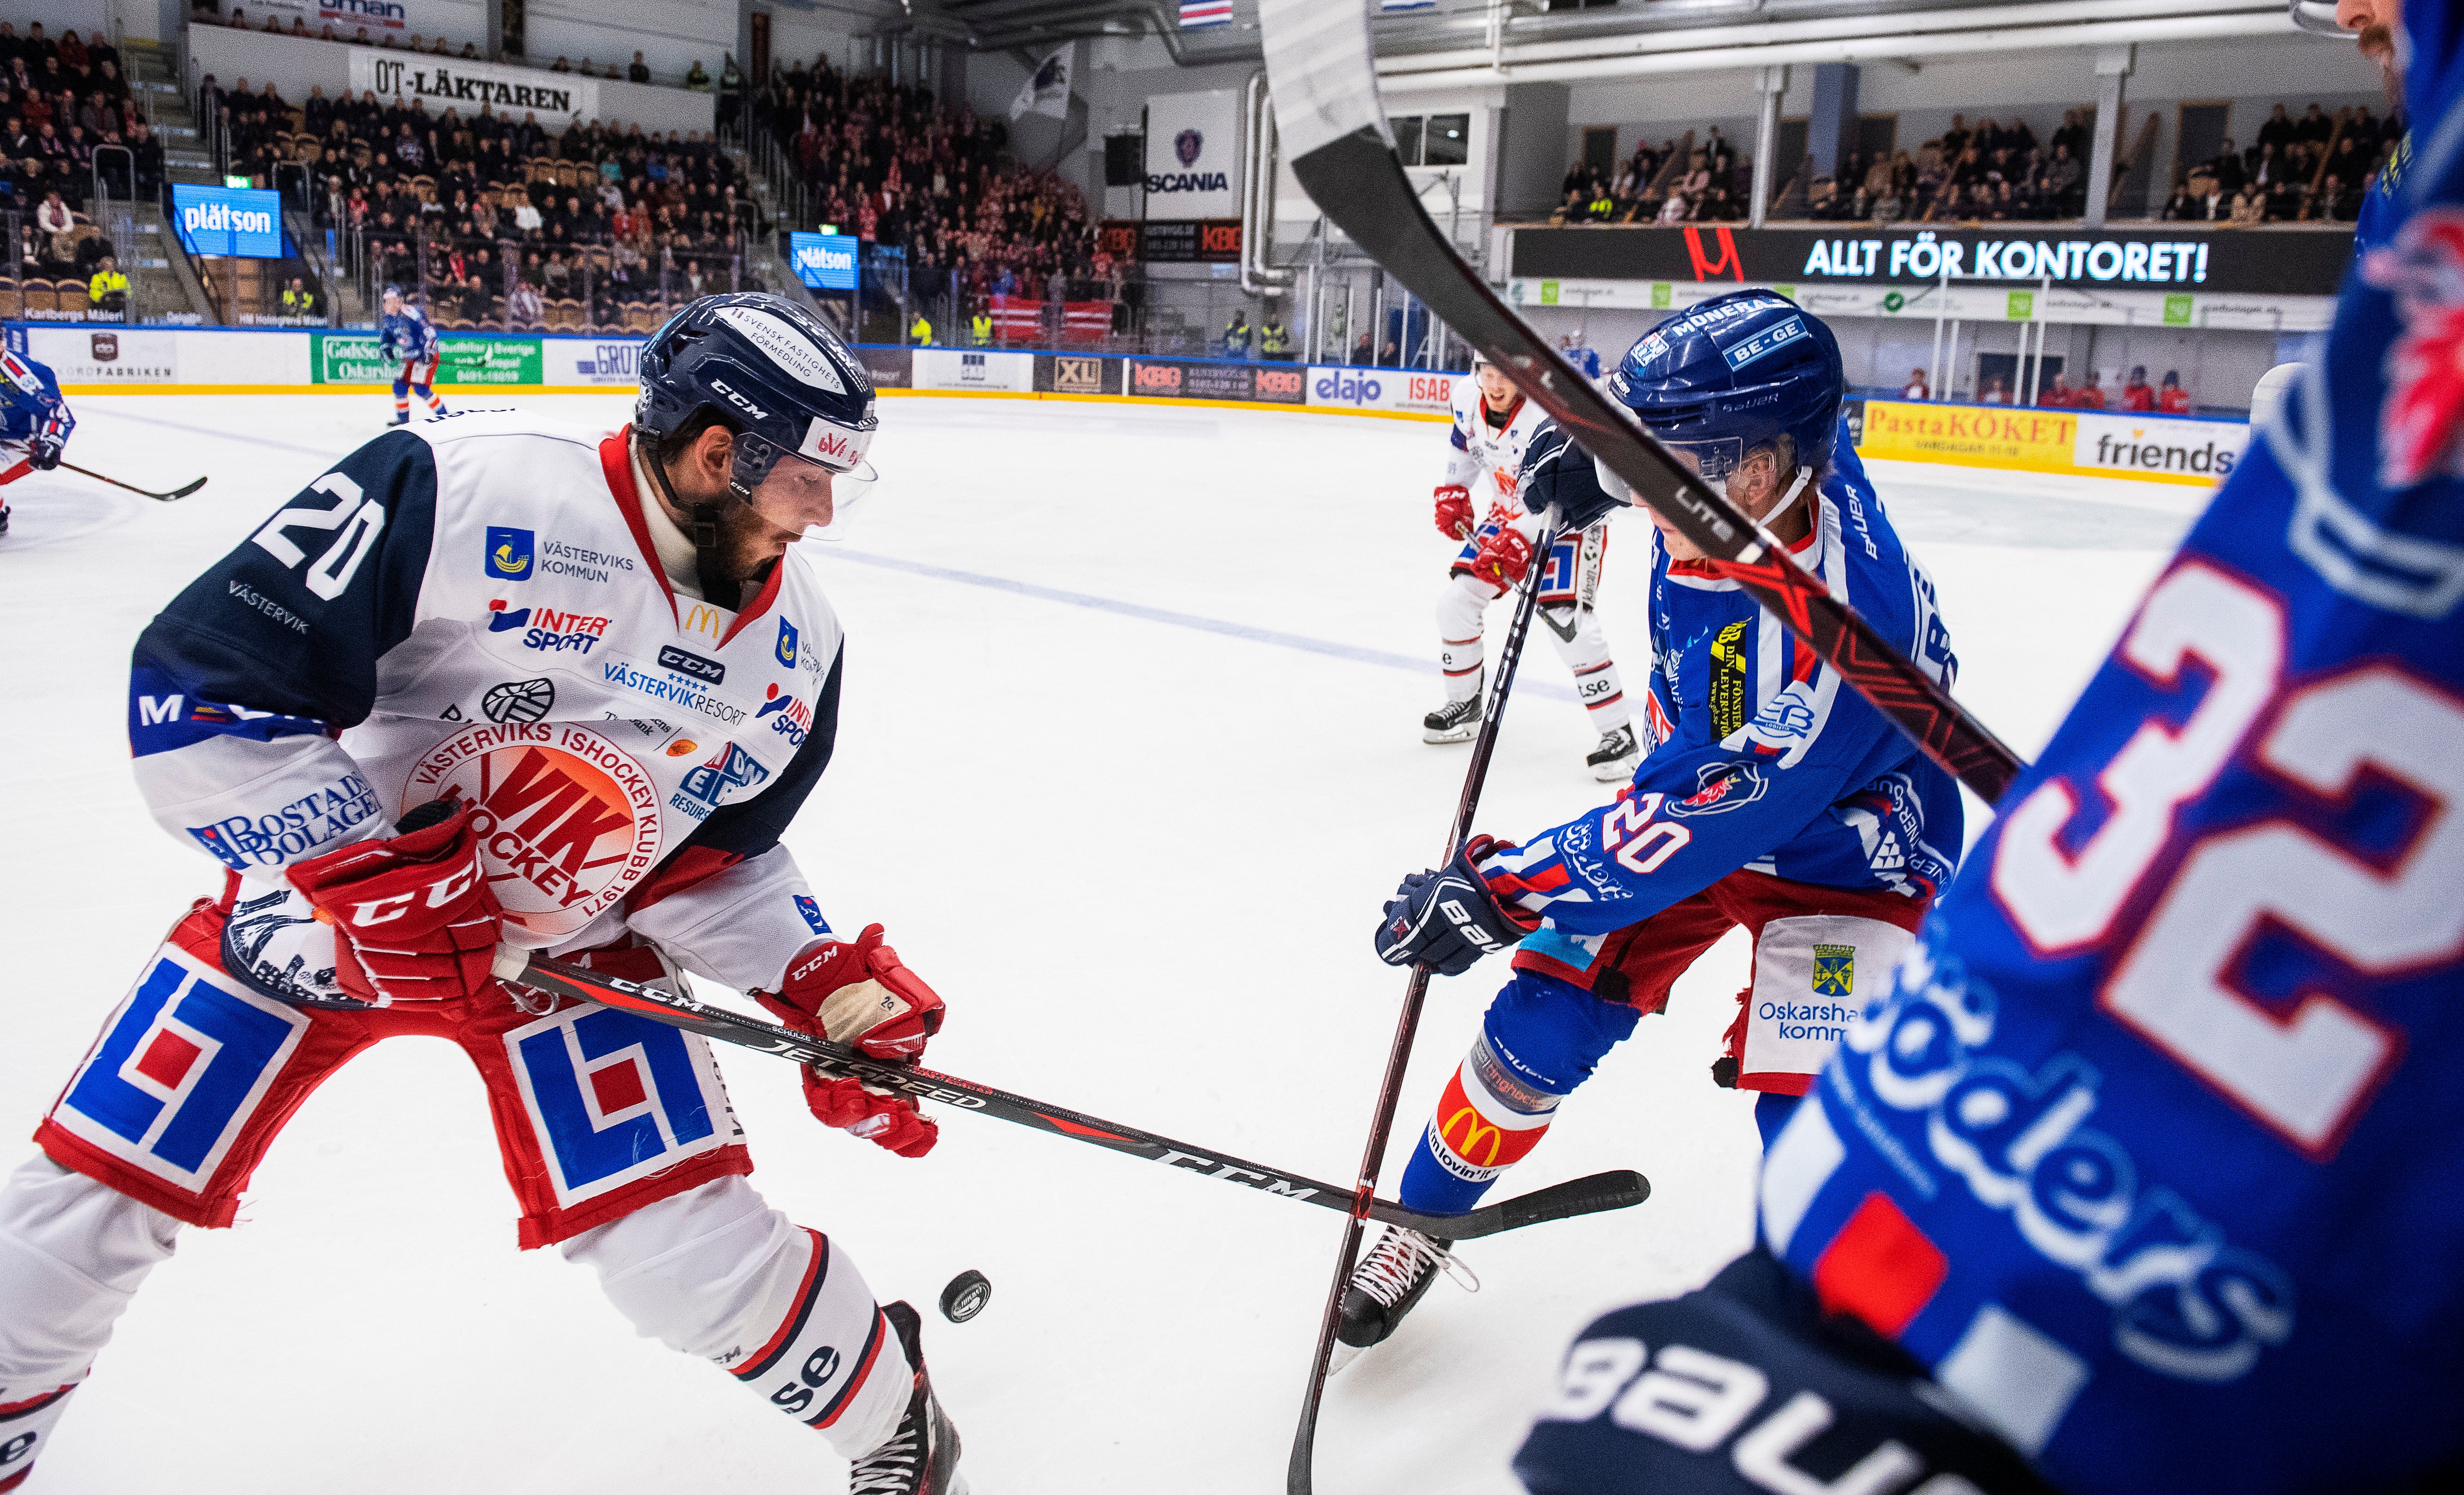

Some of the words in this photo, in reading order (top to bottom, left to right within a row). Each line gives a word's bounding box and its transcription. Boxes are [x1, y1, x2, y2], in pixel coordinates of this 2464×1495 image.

[375, 59, 571, 112] OT-LÄKTAREN
[1145, 172, 1228, 193] SCANIA
[185, 202, 271, 234] plåtson
[1803, 240, 1882, 276] ALLT
[1890, 231, 1964, 277] FÖR
[1974, 240, 2209, 283] KONTORET!
[744, 315, 784, 342] SVENSK
[784, 340, 841, 390] FASTIGHETS
[750, 332, 811, 378] FÖRMEDLING
[710, 378, 769, 420] CCM
[1315, 369, 1381, 406] elajo
[1409, 377, 1451, 402] ISAB
[1869, 408, 2075, 445] PastaKÖKET
[2098, 430, 2235, 475] friends
[730, 481, 750, 495] CCM
[251, 472, 385, 600] 20
[543, 541, 633, 571] VÄSTERVIKS
[541, 560, 608, 583] KOMMUN
[228, 579, 310, 635] VÄSTERVIK
[533, 607, 610, 636] INTER
[523, 628, 599, 654] SPORT
[661, 650, 723, 678] CCM
[416, 723, 553, 785] VÄSTERVIKS
[560, 729, 655, 810] ISHOCKEY
[486, 747, 634, 878] VIK
[1602, 792, 1692, 874] 20
[622, 816, 657, 882] KLUBB
[1989, 556, 2464, 1161] 32
[582, 885, 625, 918] 1971
[791, 945, 838, 981] CCM
[609, 976, 705, 1012] CCM
[772, 1026, 812, 1042] SCHULZE
[745, 1038, 987, 1108] JETSPEED
[1155, 1148, 1320, 1200] CCM
